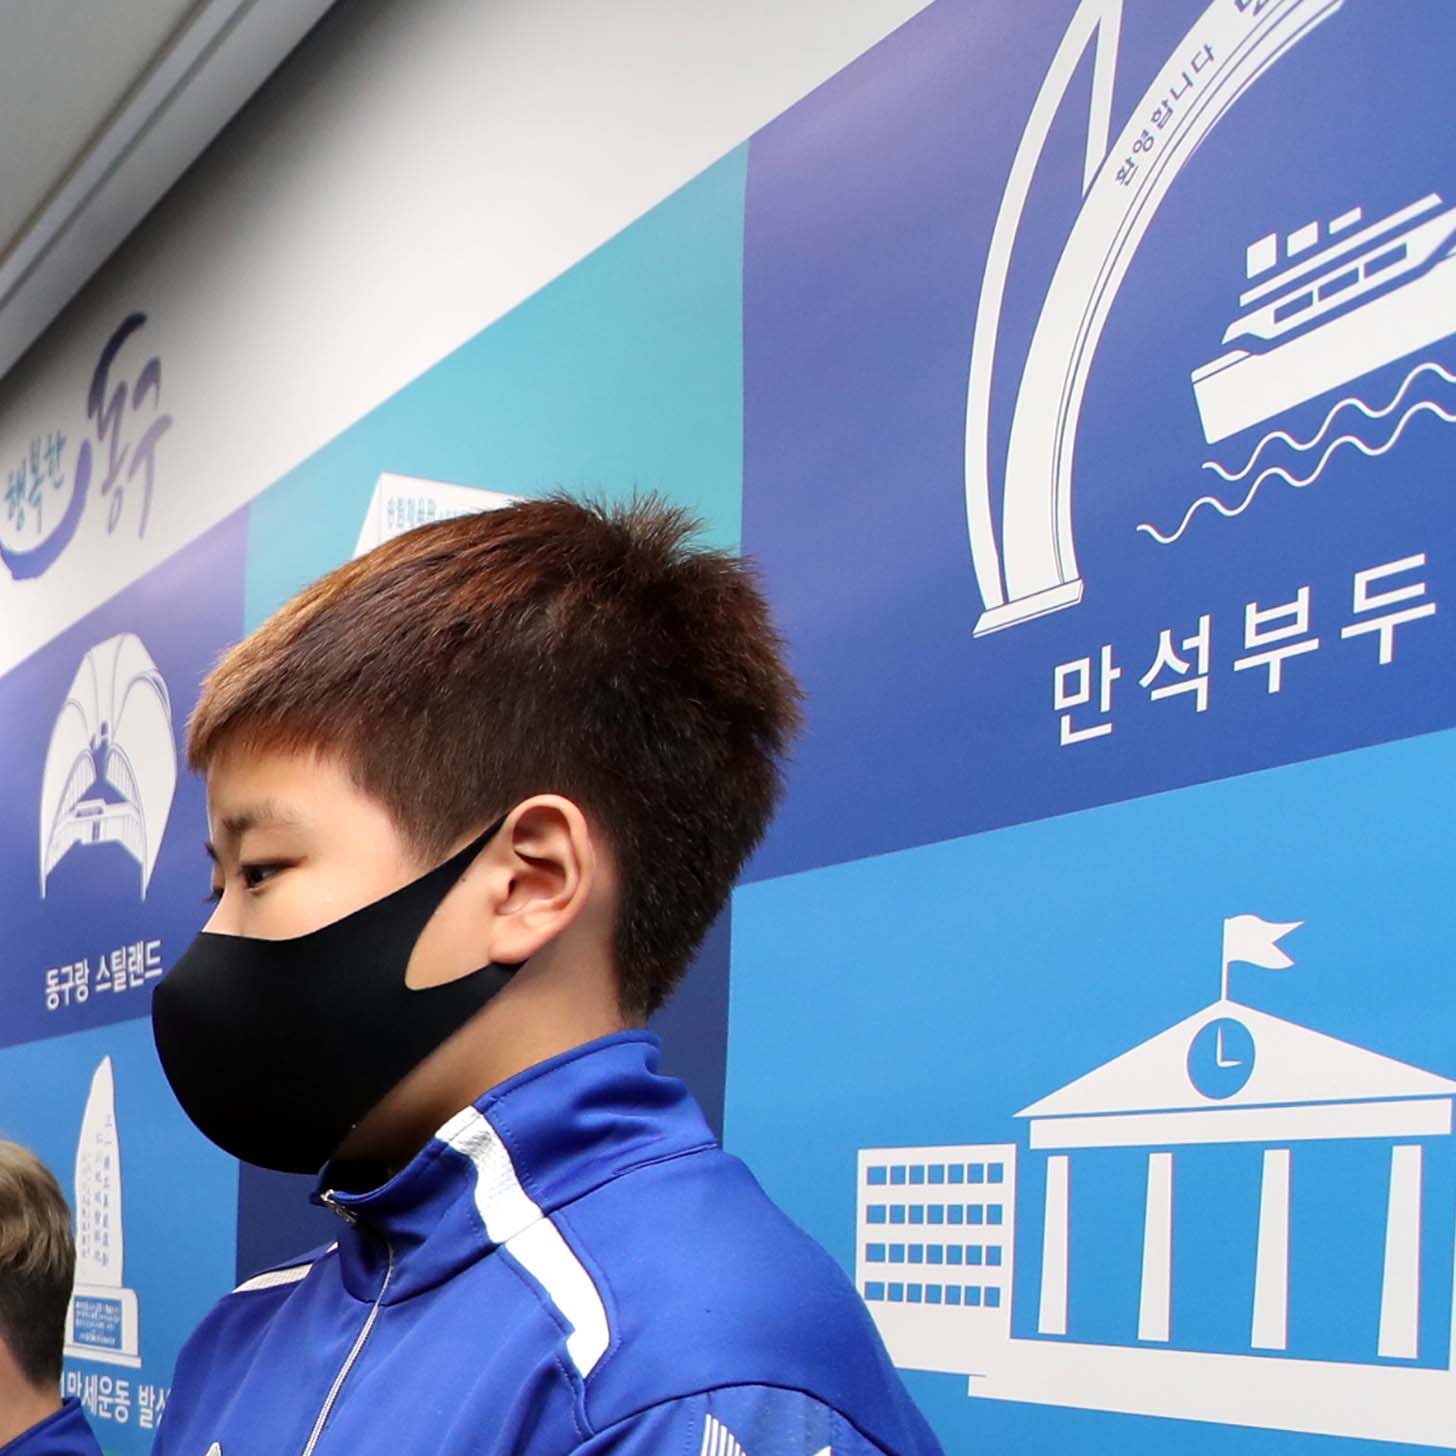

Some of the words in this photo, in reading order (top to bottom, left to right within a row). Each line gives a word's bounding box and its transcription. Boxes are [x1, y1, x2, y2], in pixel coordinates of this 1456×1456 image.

[1115, 43, 1215, 186] 환영합니다
[4, 430, 66, 534] 행복한
[1053, 552, 1437, 747] 만석부두
[45, 958, 89, 1010] 동구랑
[95, 940, 162, 993] 스틸랜드
